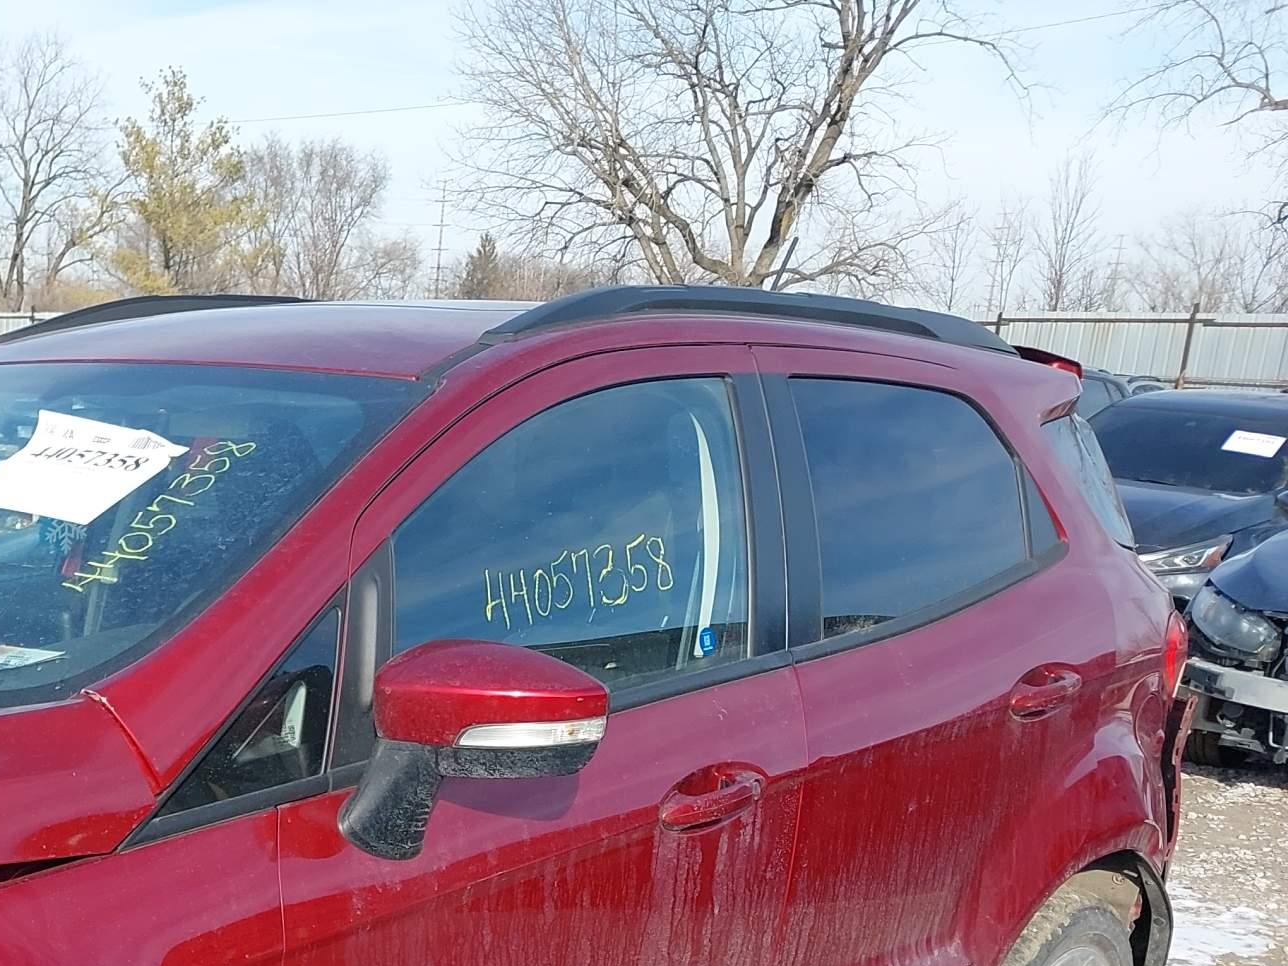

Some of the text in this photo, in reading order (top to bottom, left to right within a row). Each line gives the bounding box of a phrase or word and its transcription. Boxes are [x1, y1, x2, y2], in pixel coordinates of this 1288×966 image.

[31, 446, 150, 472] 44057358
[63, 440, 257, 592] 44057358
[484, 534, 674, 630] 44057358
